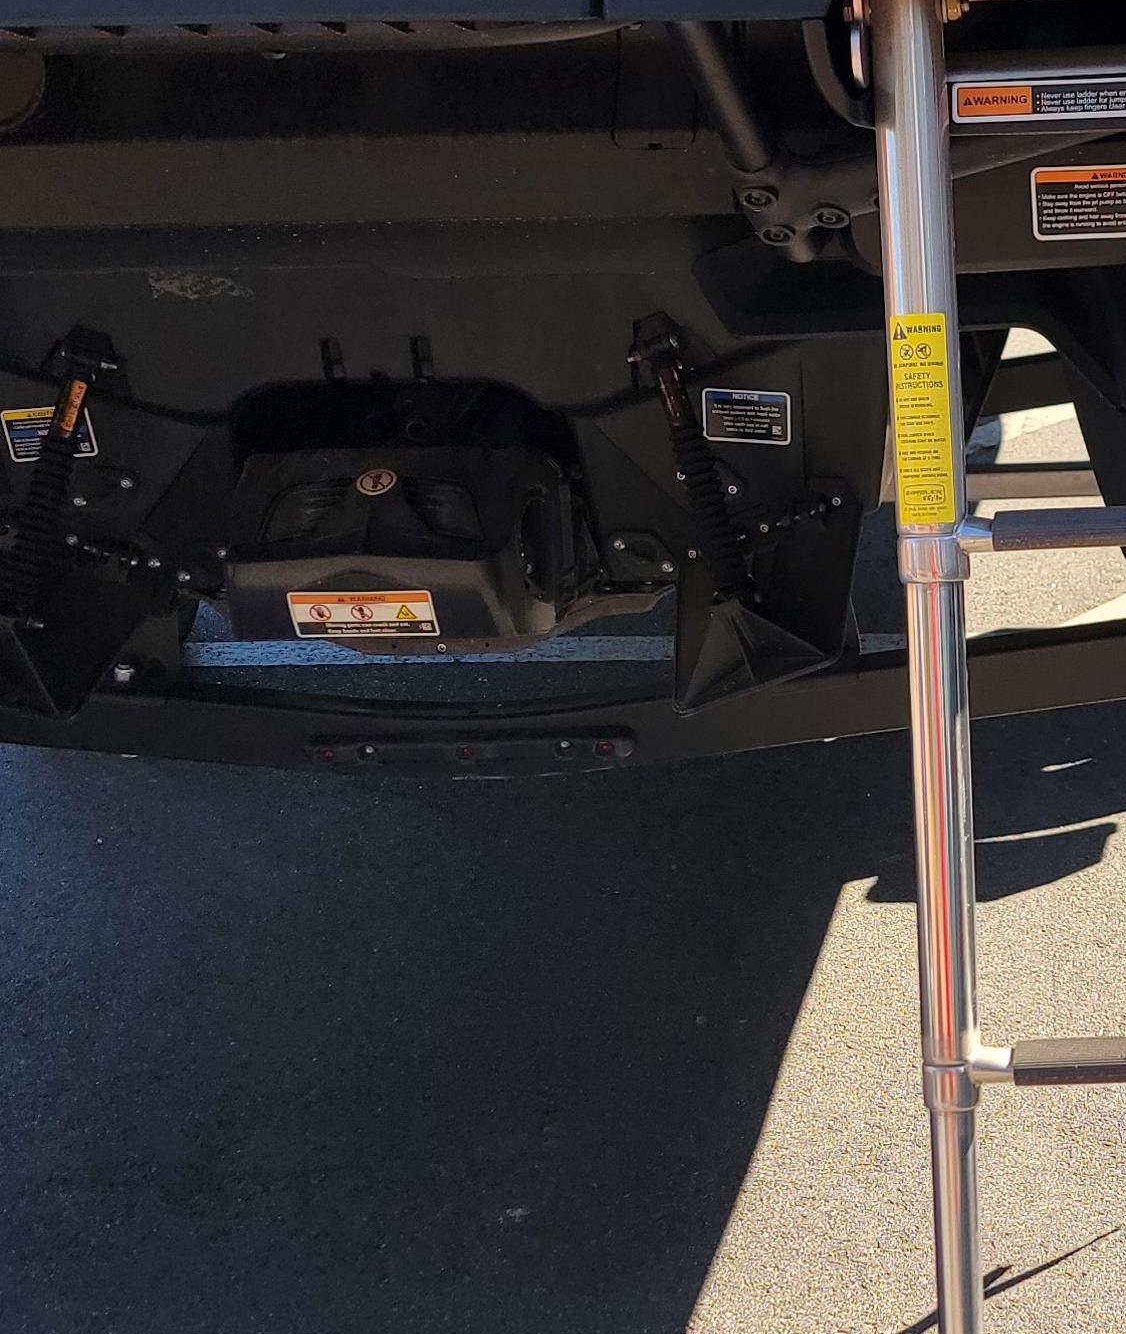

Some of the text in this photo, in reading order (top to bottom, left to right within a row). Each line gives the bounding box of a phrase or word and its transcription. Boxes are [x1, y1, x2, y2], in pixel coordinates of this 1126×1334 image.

[1100, 89, 1117, 97] when
[973, 95, 1027, 105] WARNING
[1077, 97, 1097, 105] ladder
[1084, 104, 1107, 112] fingers
[906, 325, 942, 334] WARNING
[904, 372, 931, 380] SAFETY
[896, 380, 944, 389] INSTRUCTIONS
[732, 393, 760, 401] NOTICE
